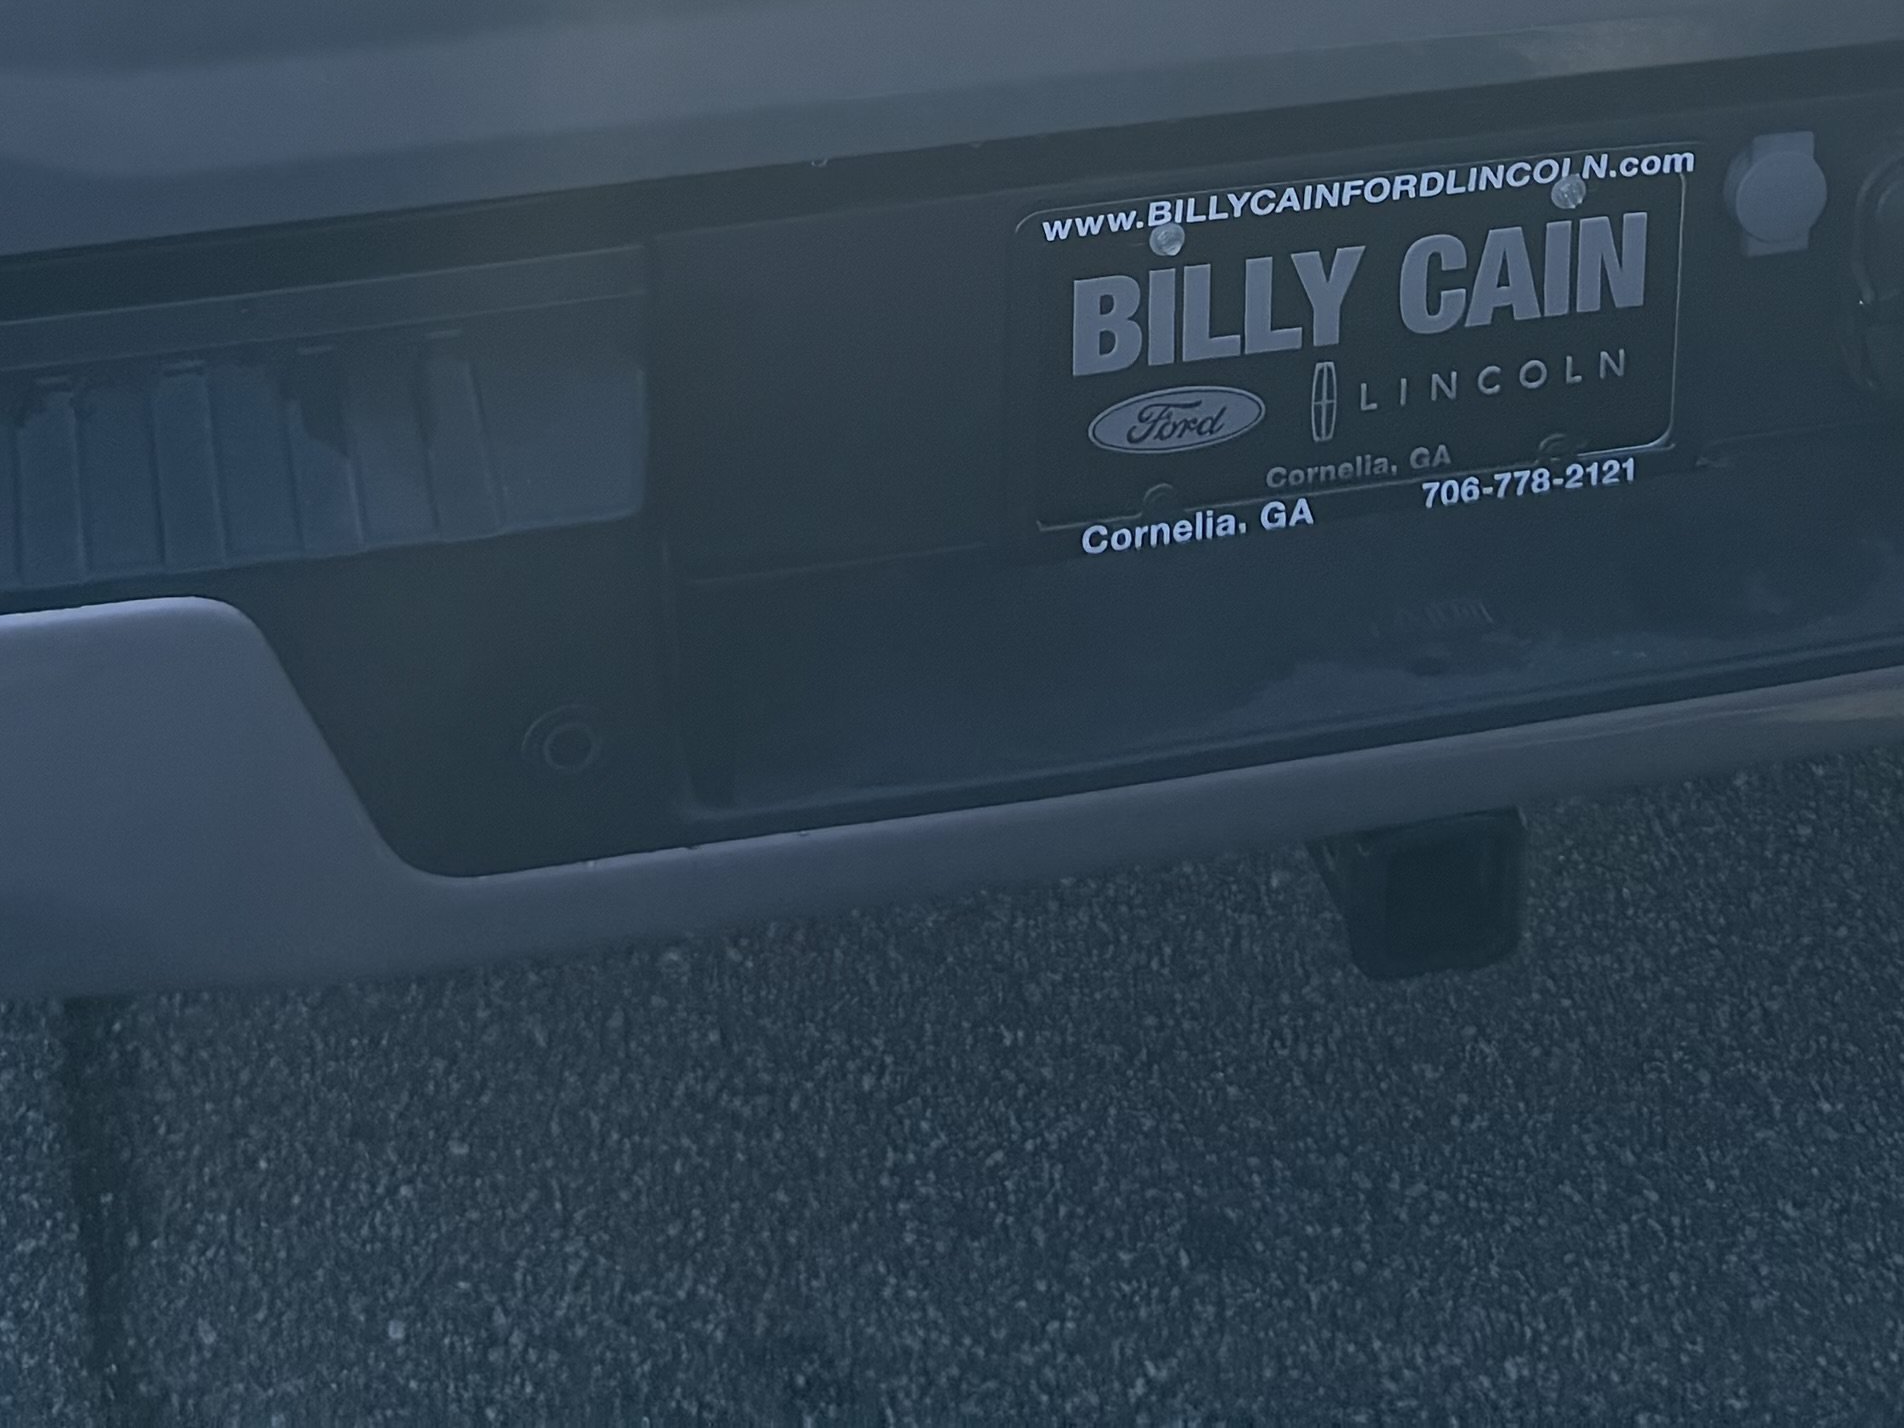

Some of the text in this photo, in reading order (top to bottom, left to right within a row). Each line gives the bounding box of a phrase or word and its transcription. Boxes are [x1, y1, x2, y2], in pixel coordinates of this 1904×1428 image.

[1041, 150, 1696, 243] www.BILLYCAINFORDLINCOLN.com
[1072, 210, 1649, 377] BILLY CAIN
[1359, 347, 1626, 412] LINCOLN
[1125, 398, 1228, 445] Ford
[1265, 443, 1452, 490] Cornelia, GA
[1420, 456, 1636, 510] 706-778-2121
[1080, 496, 1315, 555] Cornelia, GA
